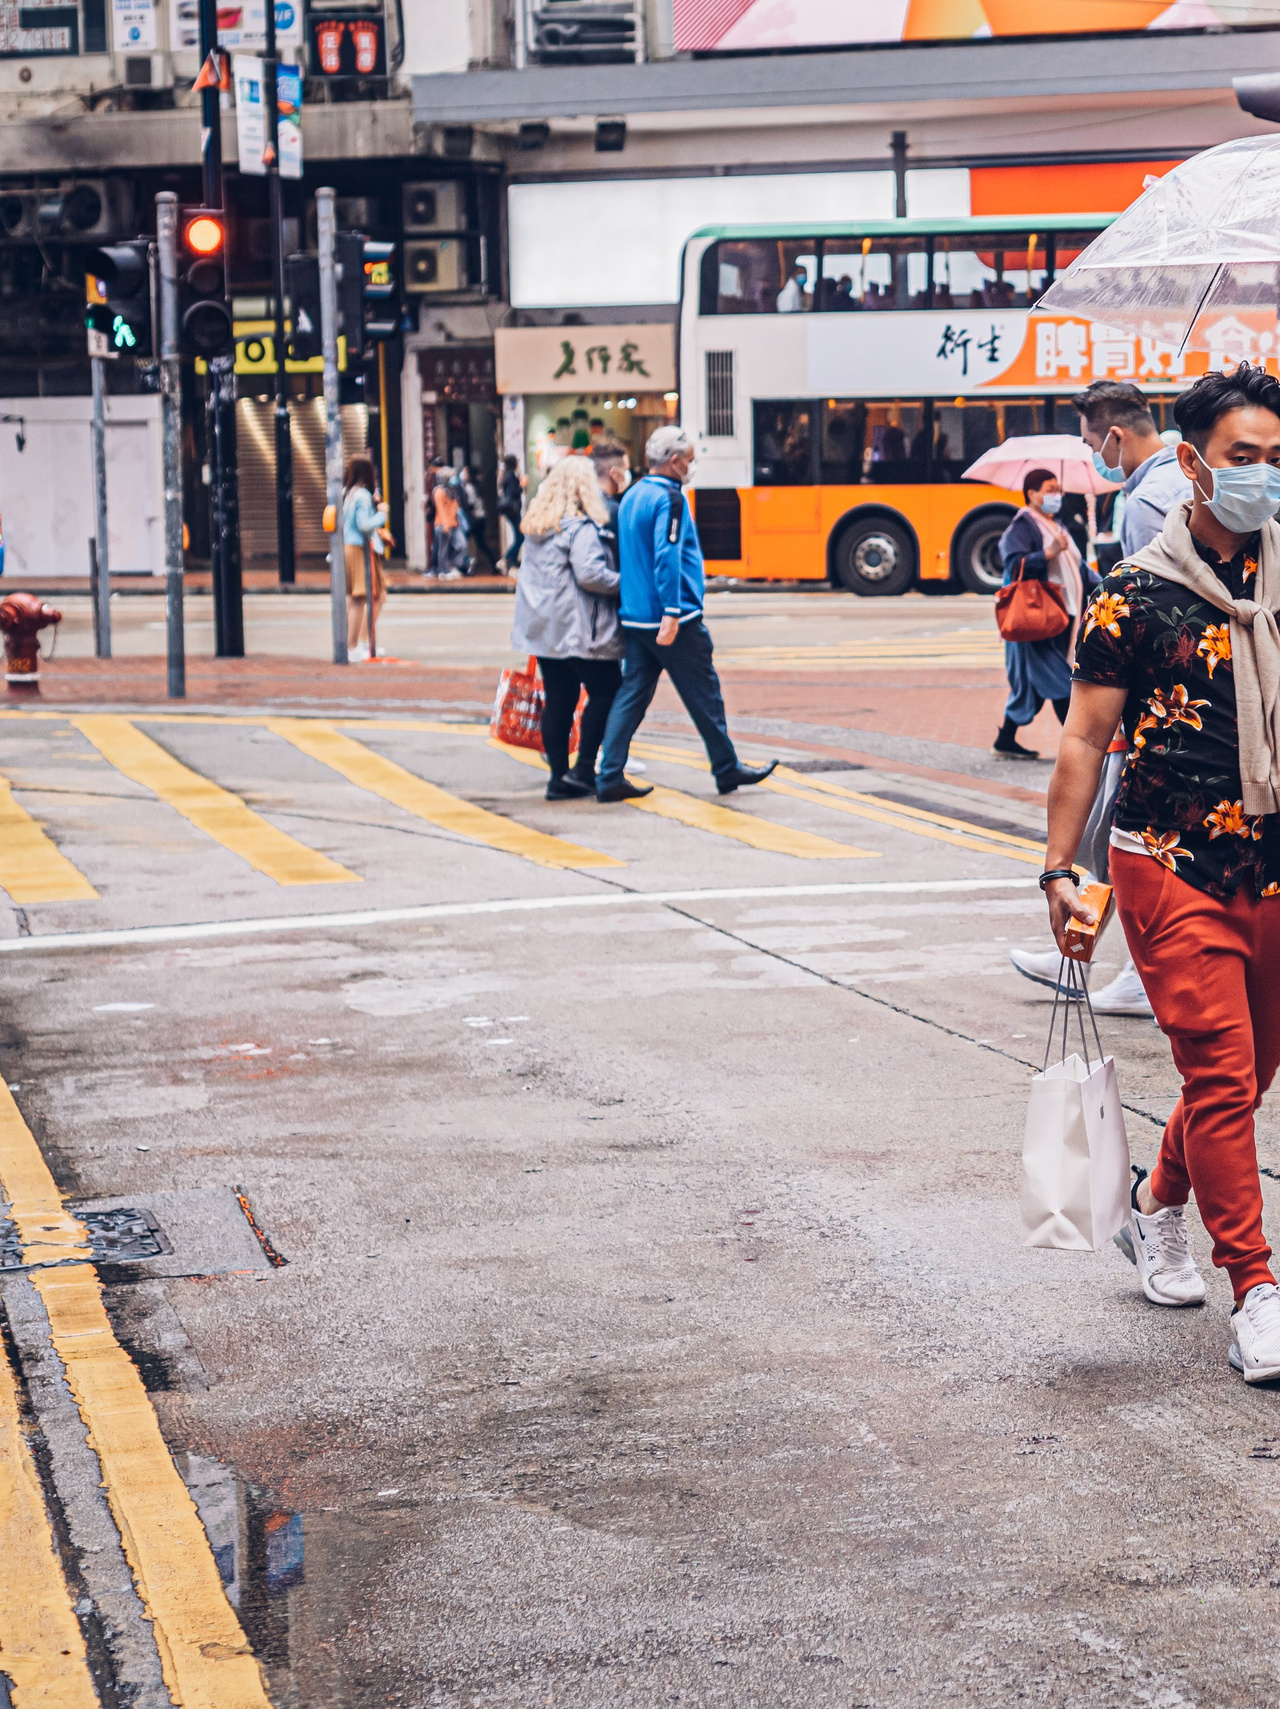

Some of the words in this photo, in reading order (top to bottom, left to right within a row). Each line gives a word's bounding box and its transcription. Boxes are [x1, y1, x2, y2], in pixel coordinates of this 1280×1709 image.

[936, 323, 1002, 376] 衍生
[1035, 321, 1186, 377] 脾胃好
